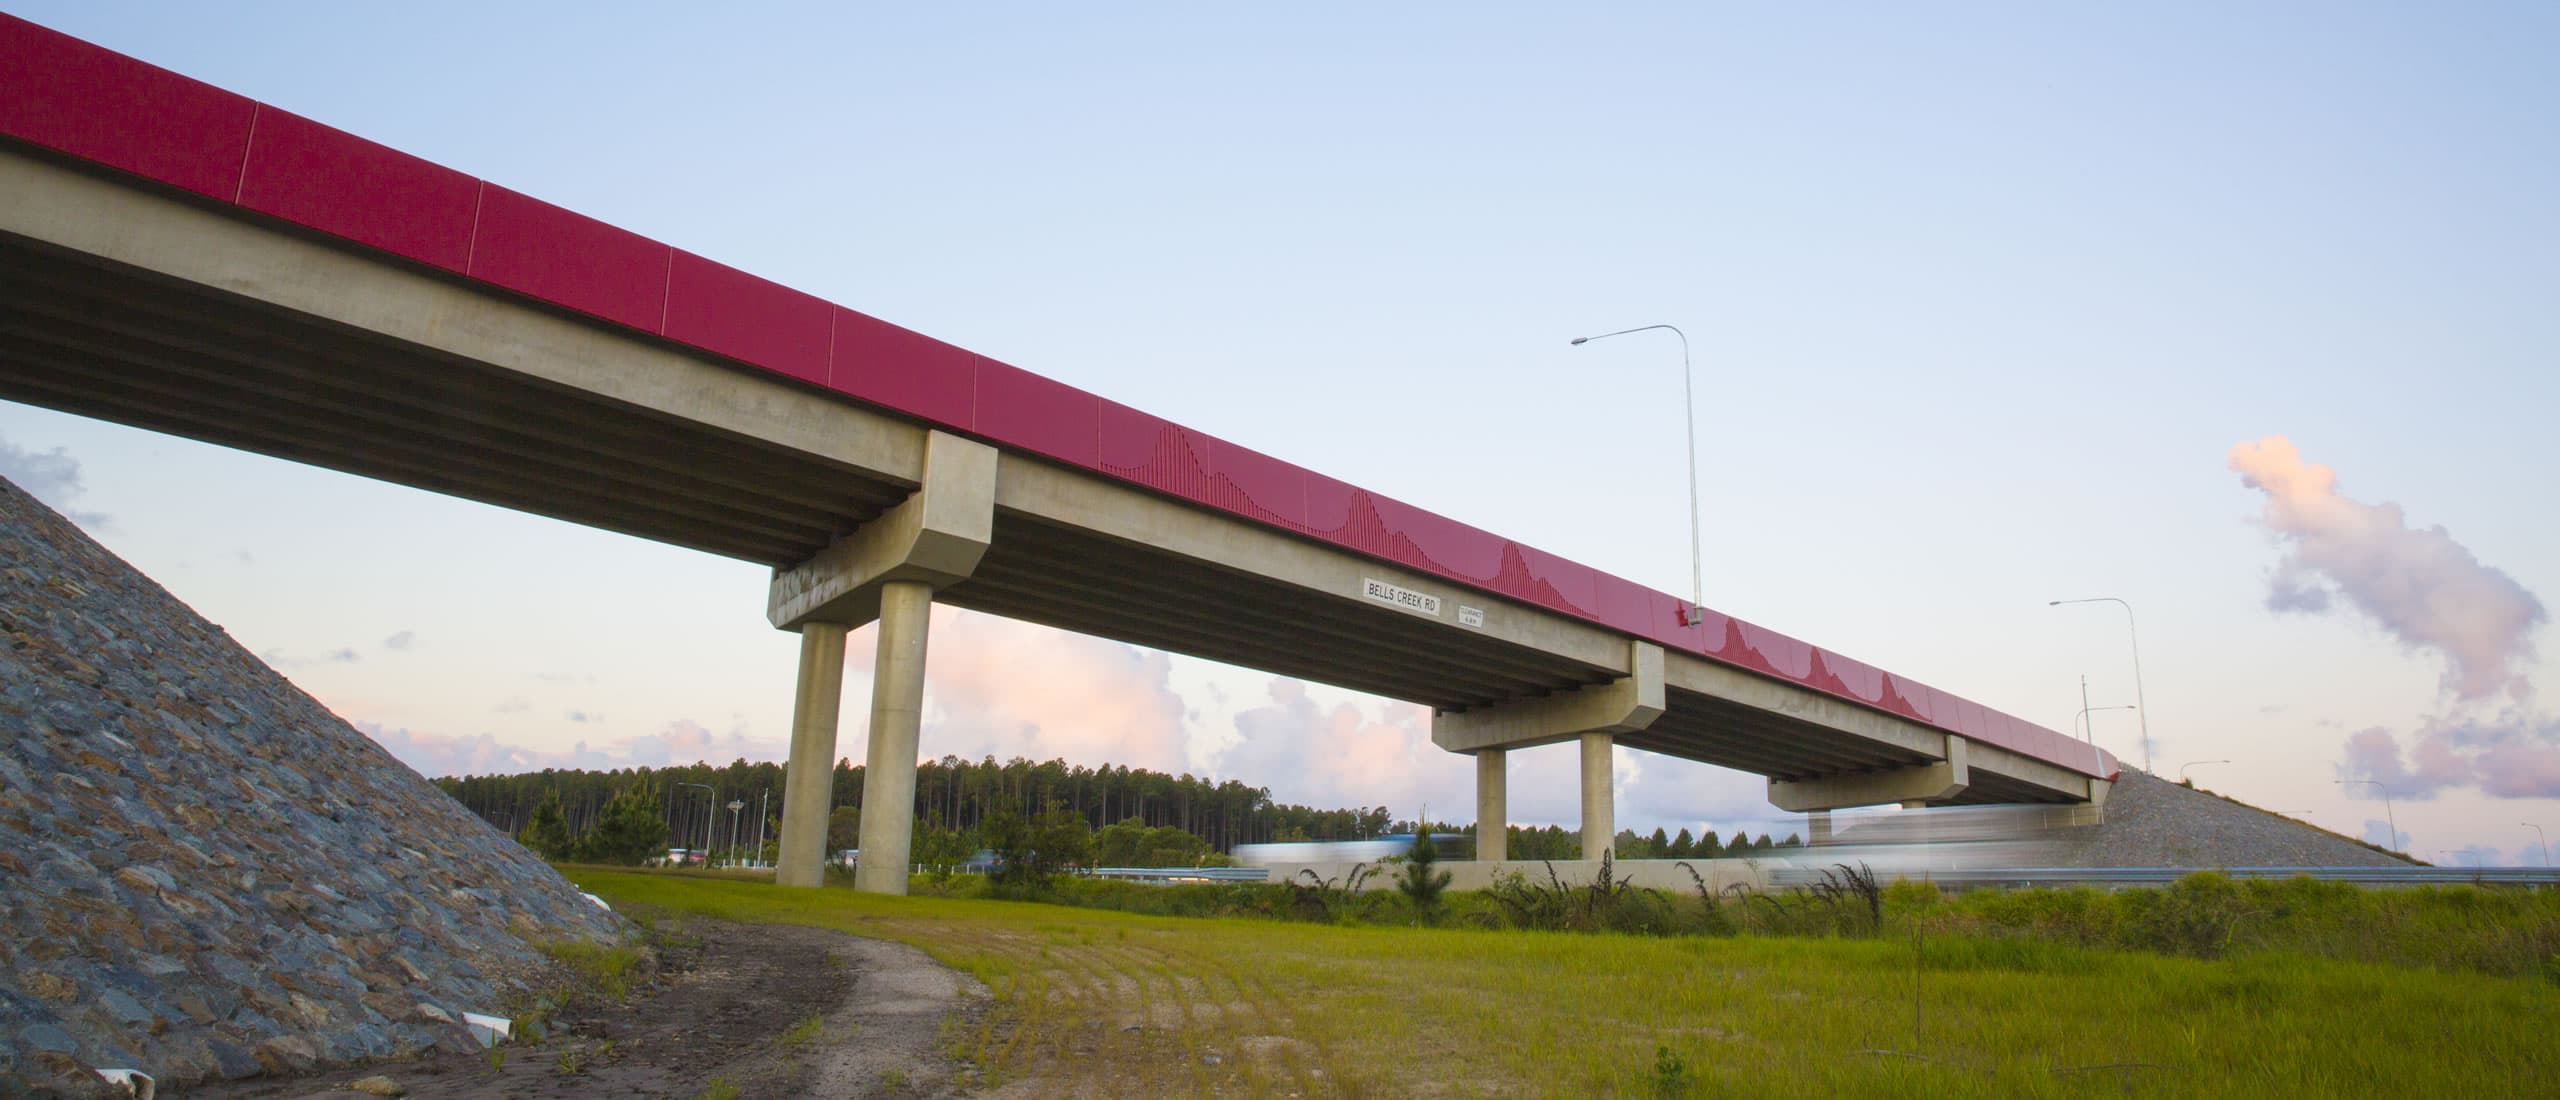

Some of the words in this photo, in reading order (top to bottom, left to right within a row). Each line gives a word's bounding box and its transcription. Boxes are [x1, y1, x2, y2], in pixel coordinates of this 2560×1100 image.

[1368, 583, 1394, 601] BELLS
[1397, 591, 1422, 609] CREEK
[1424, 598, 1436, 612] RD
